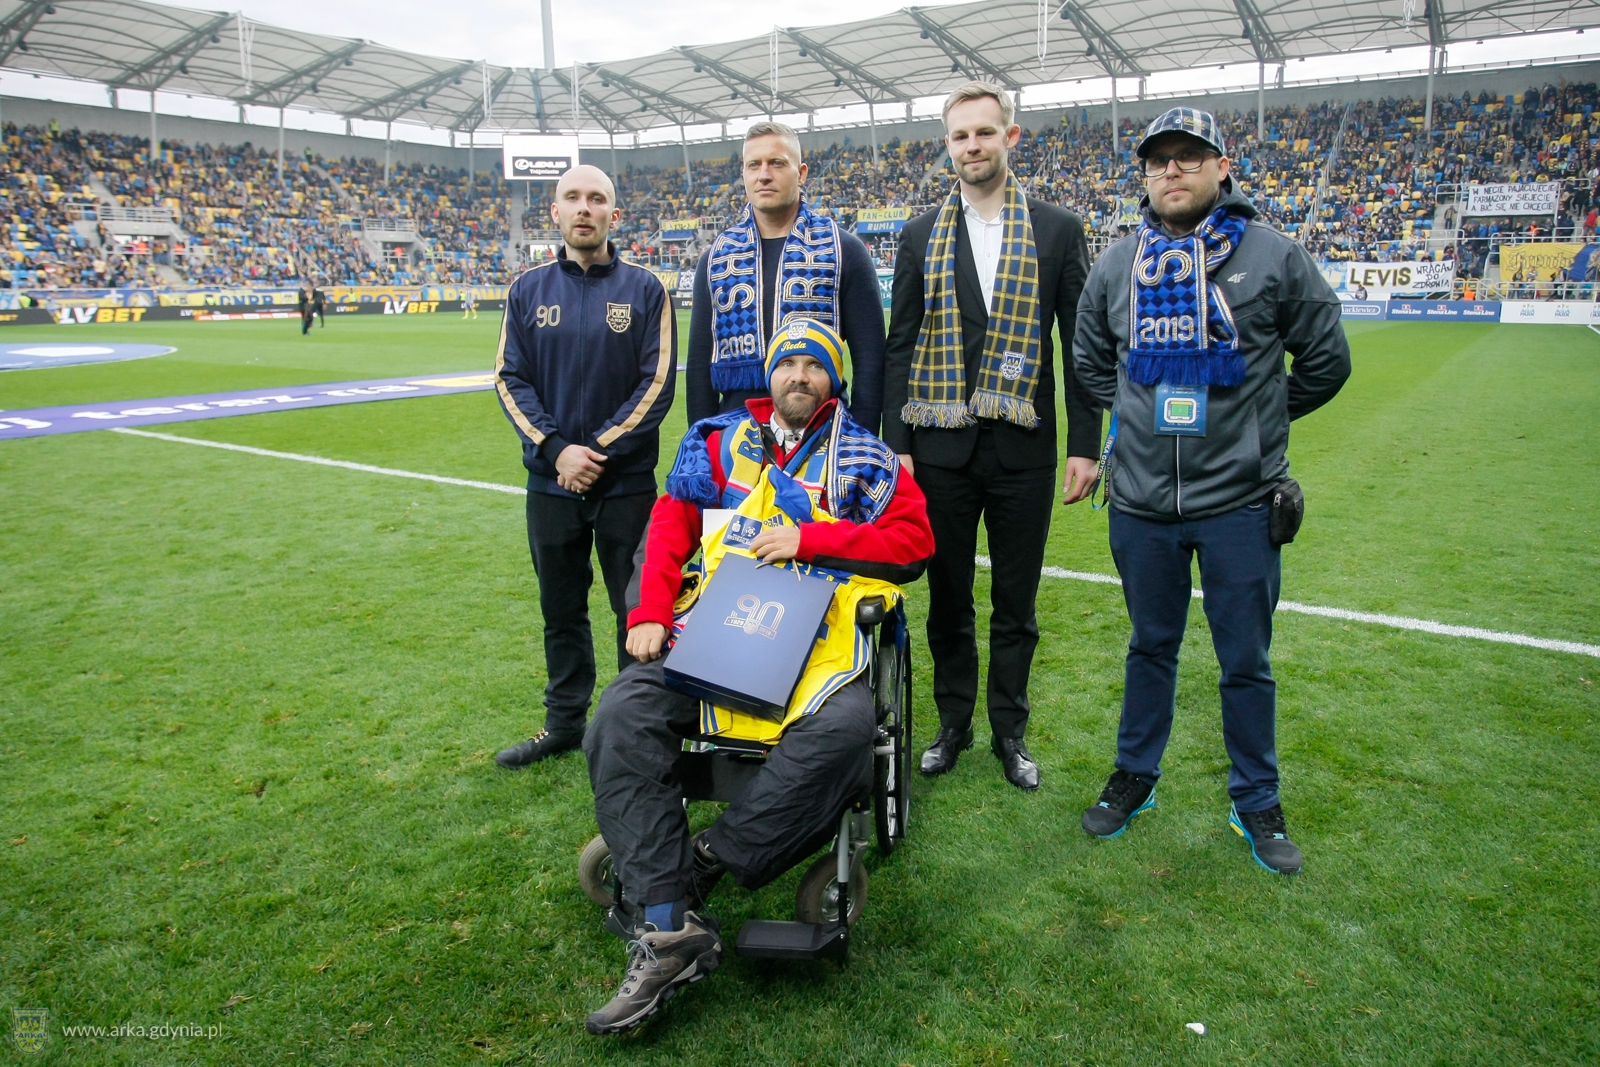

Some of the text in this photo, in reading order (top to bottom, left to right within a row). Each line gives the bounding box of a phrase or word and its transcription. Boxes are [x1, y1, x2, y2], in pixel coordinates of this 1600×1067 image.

[862, 210, 904, 220] FAN-CLUB
[867, 222, 896, 231] RUMIA
[1227, 272, 1247, 284] 4F
[1350, 267, 1411, 287] LEVIS
[1416, 261, 1454, 275] WRACAJ
[536, 304, 561, 328] 90
[1140, 314, 1195, 343] 2019
[720, 333, 756, 360] 2019
[781, 341, 807, 352] Reda
[71, 395, 313, 420] teraz
[317, 385, 420, 397] na
[736, 593, 785, 632] 90
